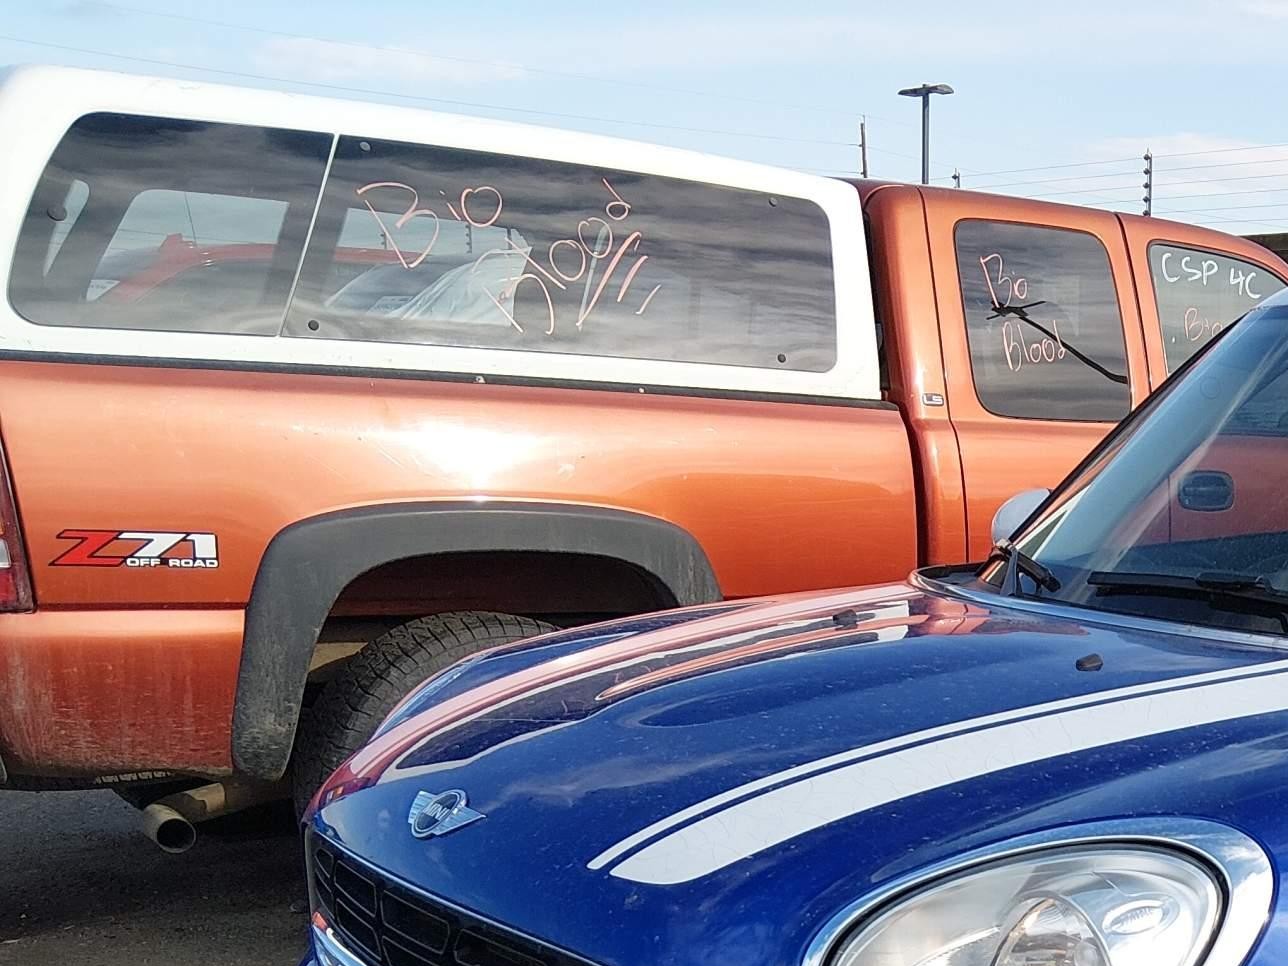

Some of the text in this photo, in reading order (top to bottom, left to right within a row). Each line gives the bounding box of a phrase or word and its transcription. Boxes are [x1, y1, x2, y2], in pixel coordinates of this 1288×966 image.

[980, 253, 1027, 308] Bio
[1162, 252, 1262, 299] CSP 4C
[1002, 320, 1066, 372] Blood
[48, 529, 219, 567] Z71
[126, 558, 219, 568] OFF ROAD
